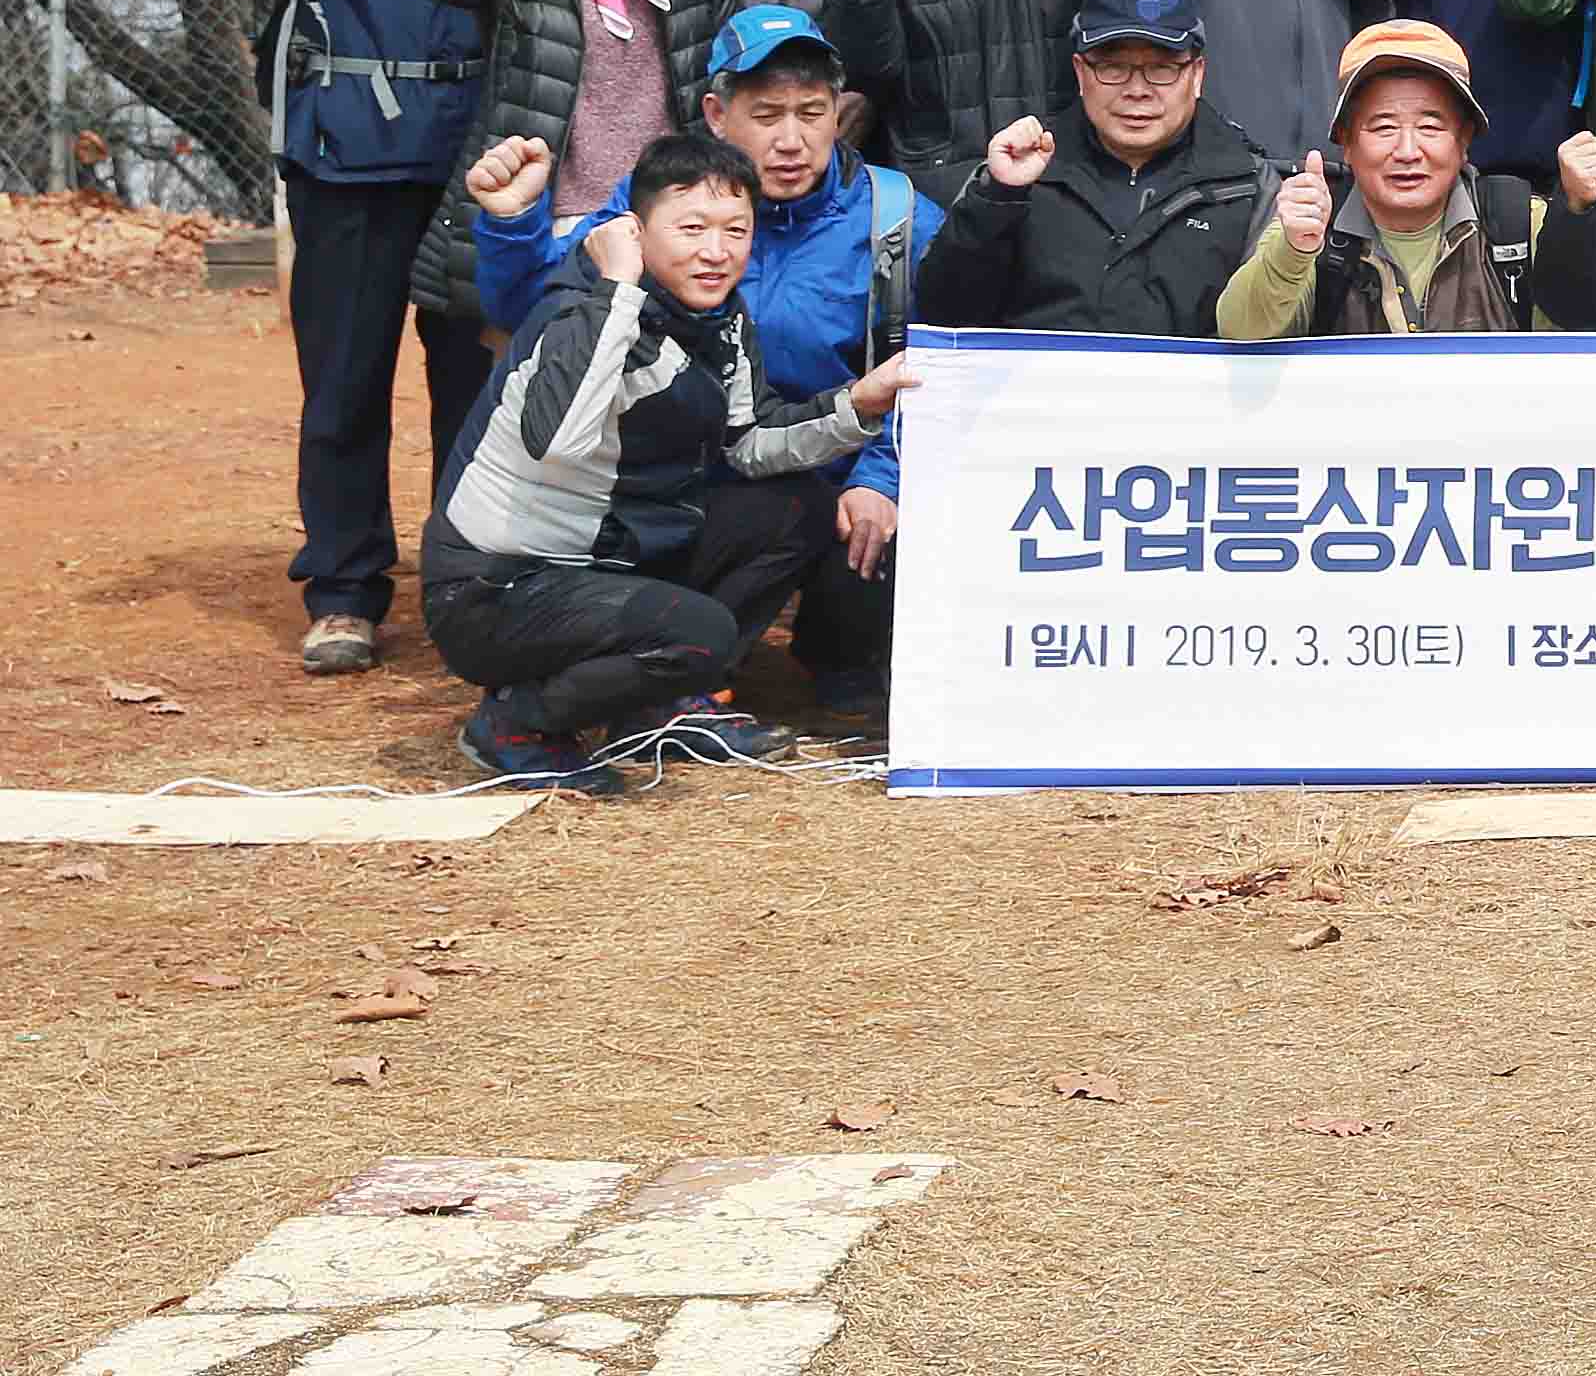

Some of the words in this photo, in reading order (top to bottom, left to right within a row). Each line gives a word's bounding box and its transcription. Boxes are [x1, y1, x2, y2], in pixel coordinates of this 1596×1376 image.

[1186, 218, 1211, 231] FILA
[1031, 624, 1107, 667] 일시
[1165, 625, 1277, 667] 2019.
[1296, 625, 1329, 667] 3.
[1347, 625, 1464, 667] 30(토)
